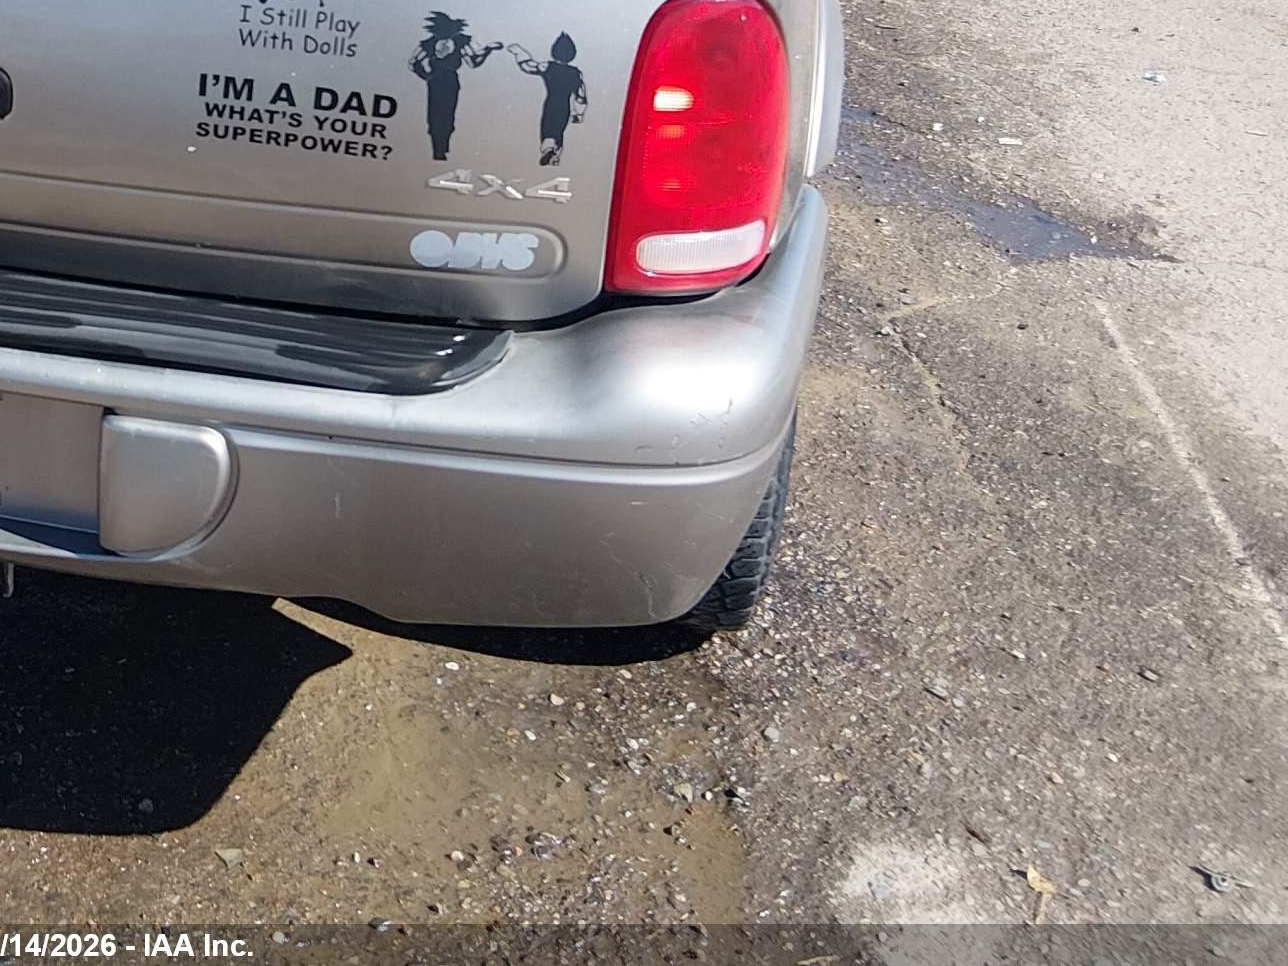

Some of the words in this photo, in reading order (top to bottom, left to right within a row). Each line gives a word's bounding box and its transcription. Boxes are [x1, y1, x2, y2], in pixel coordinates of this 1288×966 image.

[240, 4, 252, 23] I
[260, 7, 308, 28] Still
[315, 11, 361, 39] Play
[239, 28, 292, 51] With
[304, 34, 358, 57] Dolls
[198, 73, 254, 102] I'M
[269, 82, 297, 107] A
[313, 86, 398, 119] DAD
[205, 102, 304, 128] WHAT'S
[313, 115, 388, 139] YOUR
[196, 122, 393, 161] SUPERPOWER?
